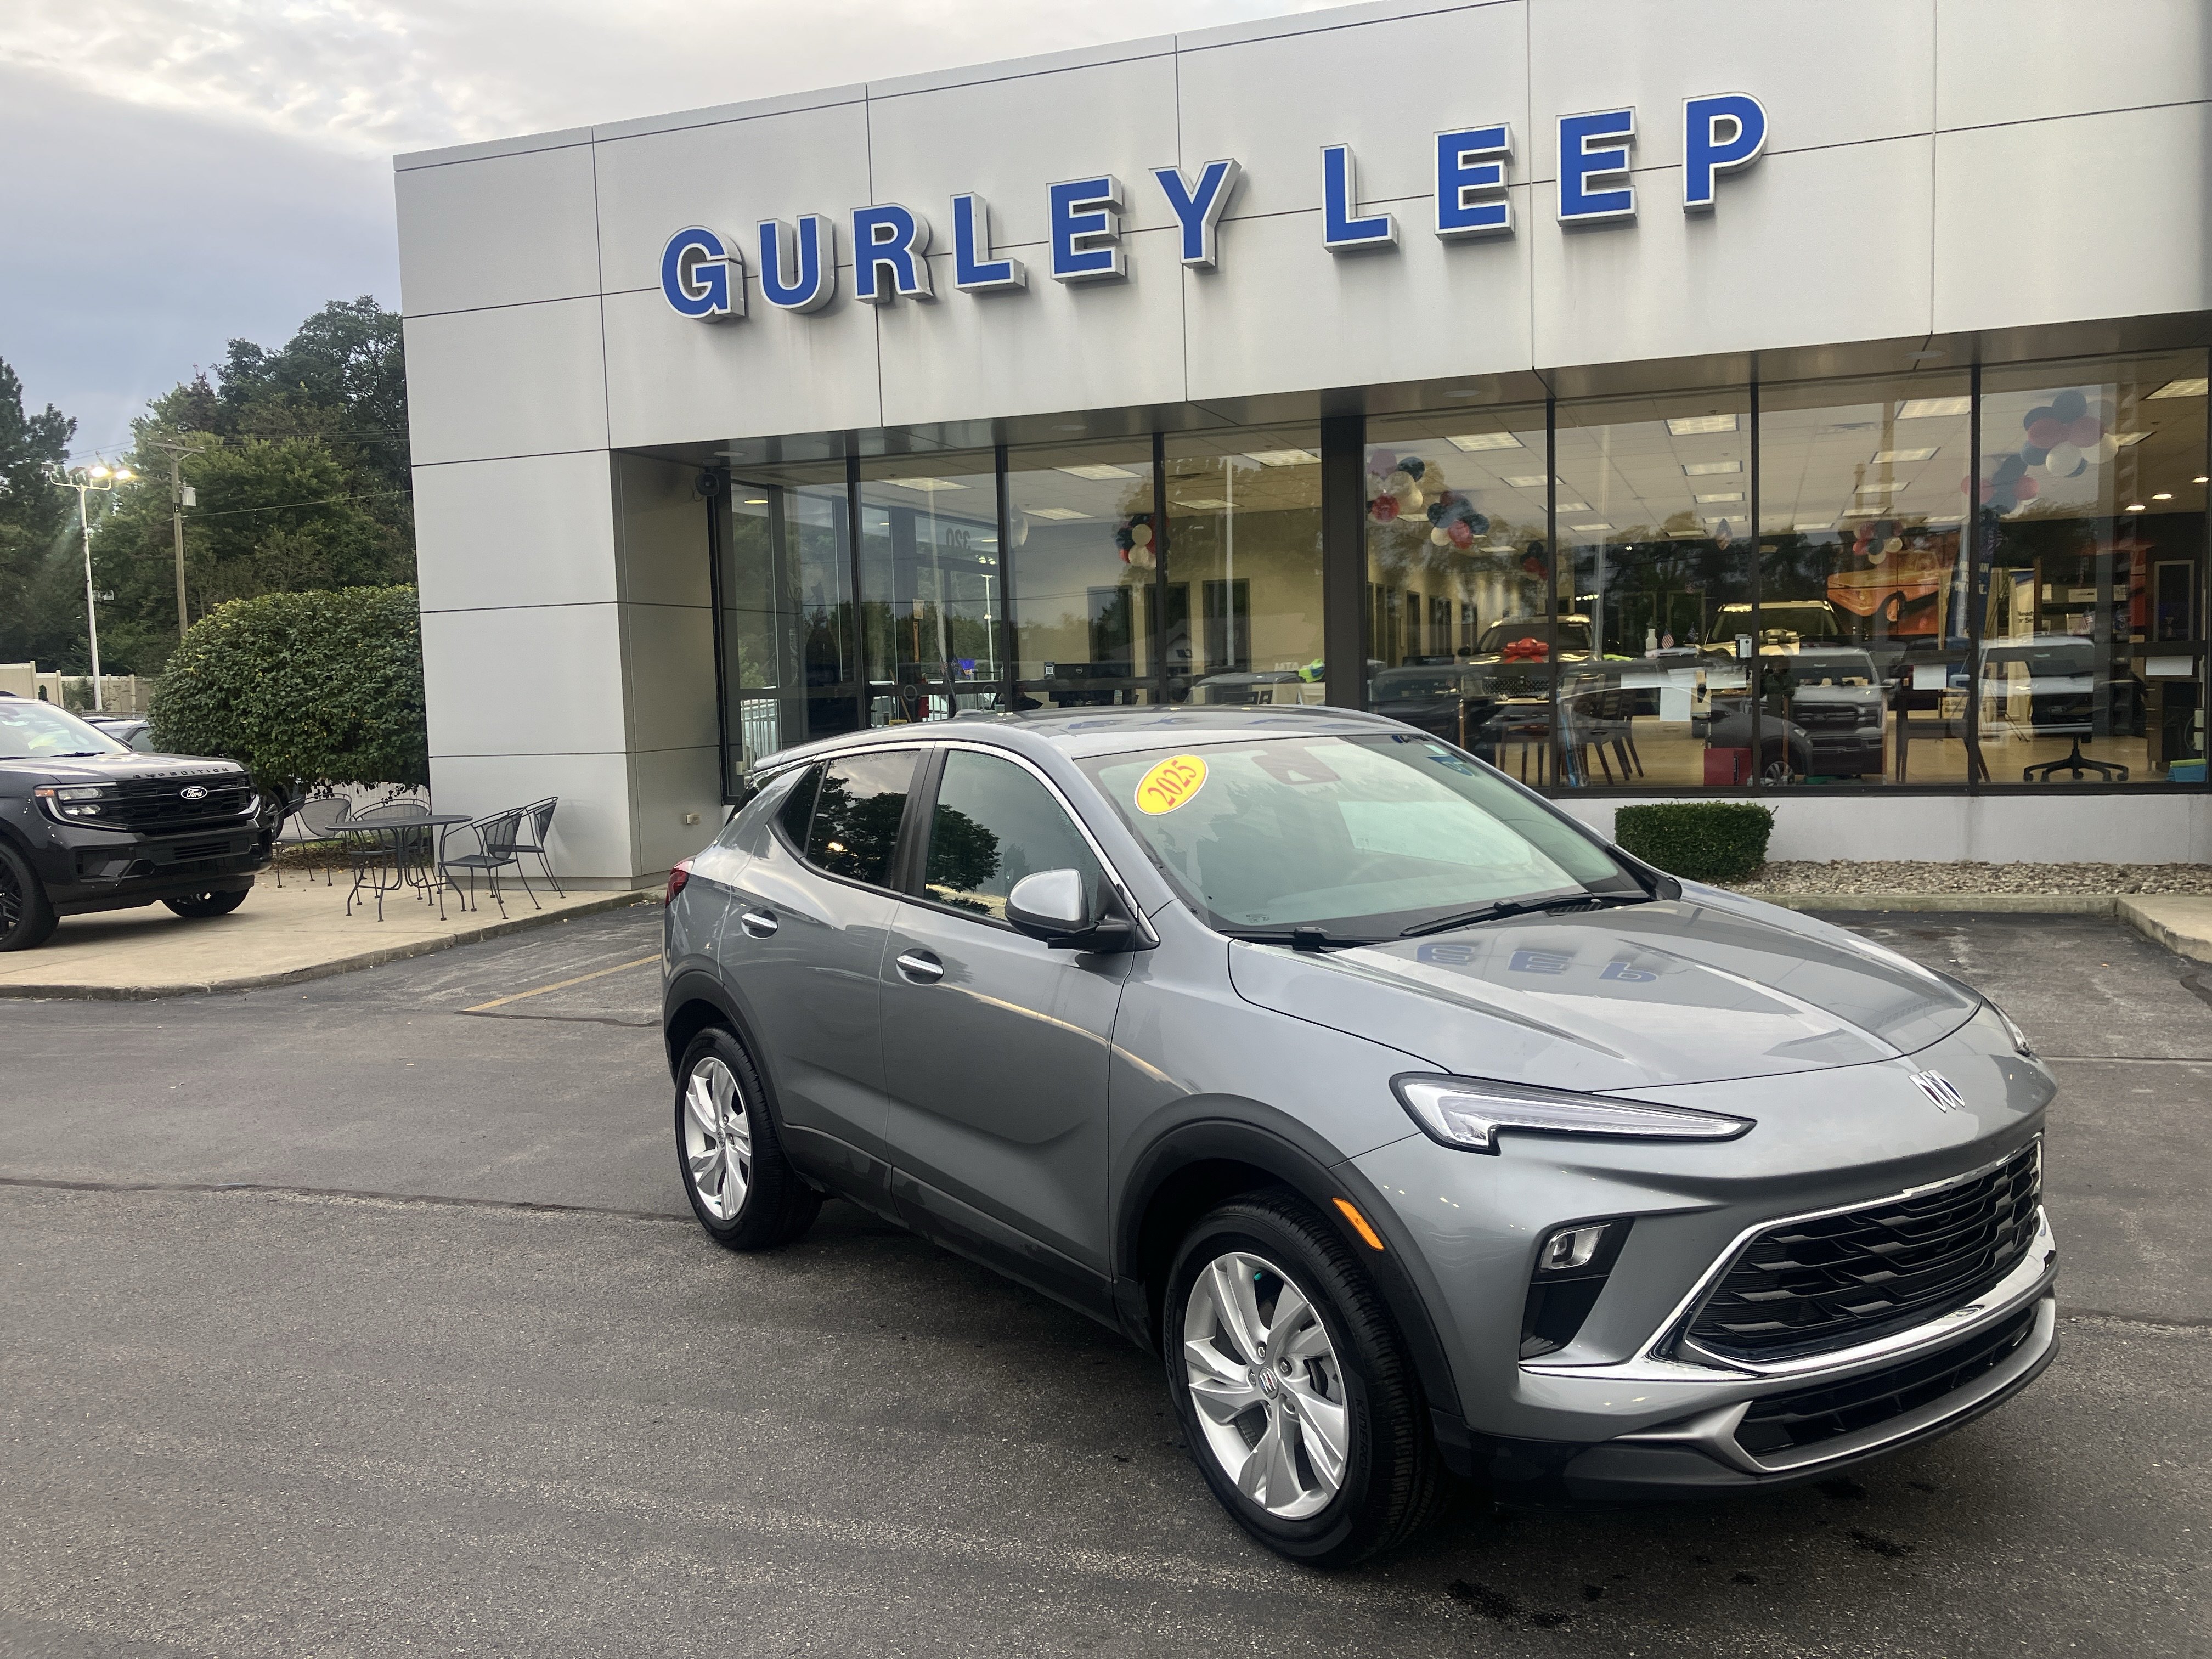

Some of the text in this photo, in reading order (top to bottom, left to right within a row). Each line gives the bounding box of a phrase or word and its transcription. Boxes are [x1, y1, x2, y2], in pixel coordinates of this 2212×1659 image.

[659, 92, 1768, 323] GURLEY LEEP
[133, 768, 229, 778] EXPEDITION
[1148, 760, 1196, 806] 2025
[186, 788, 202, 798] Ford
